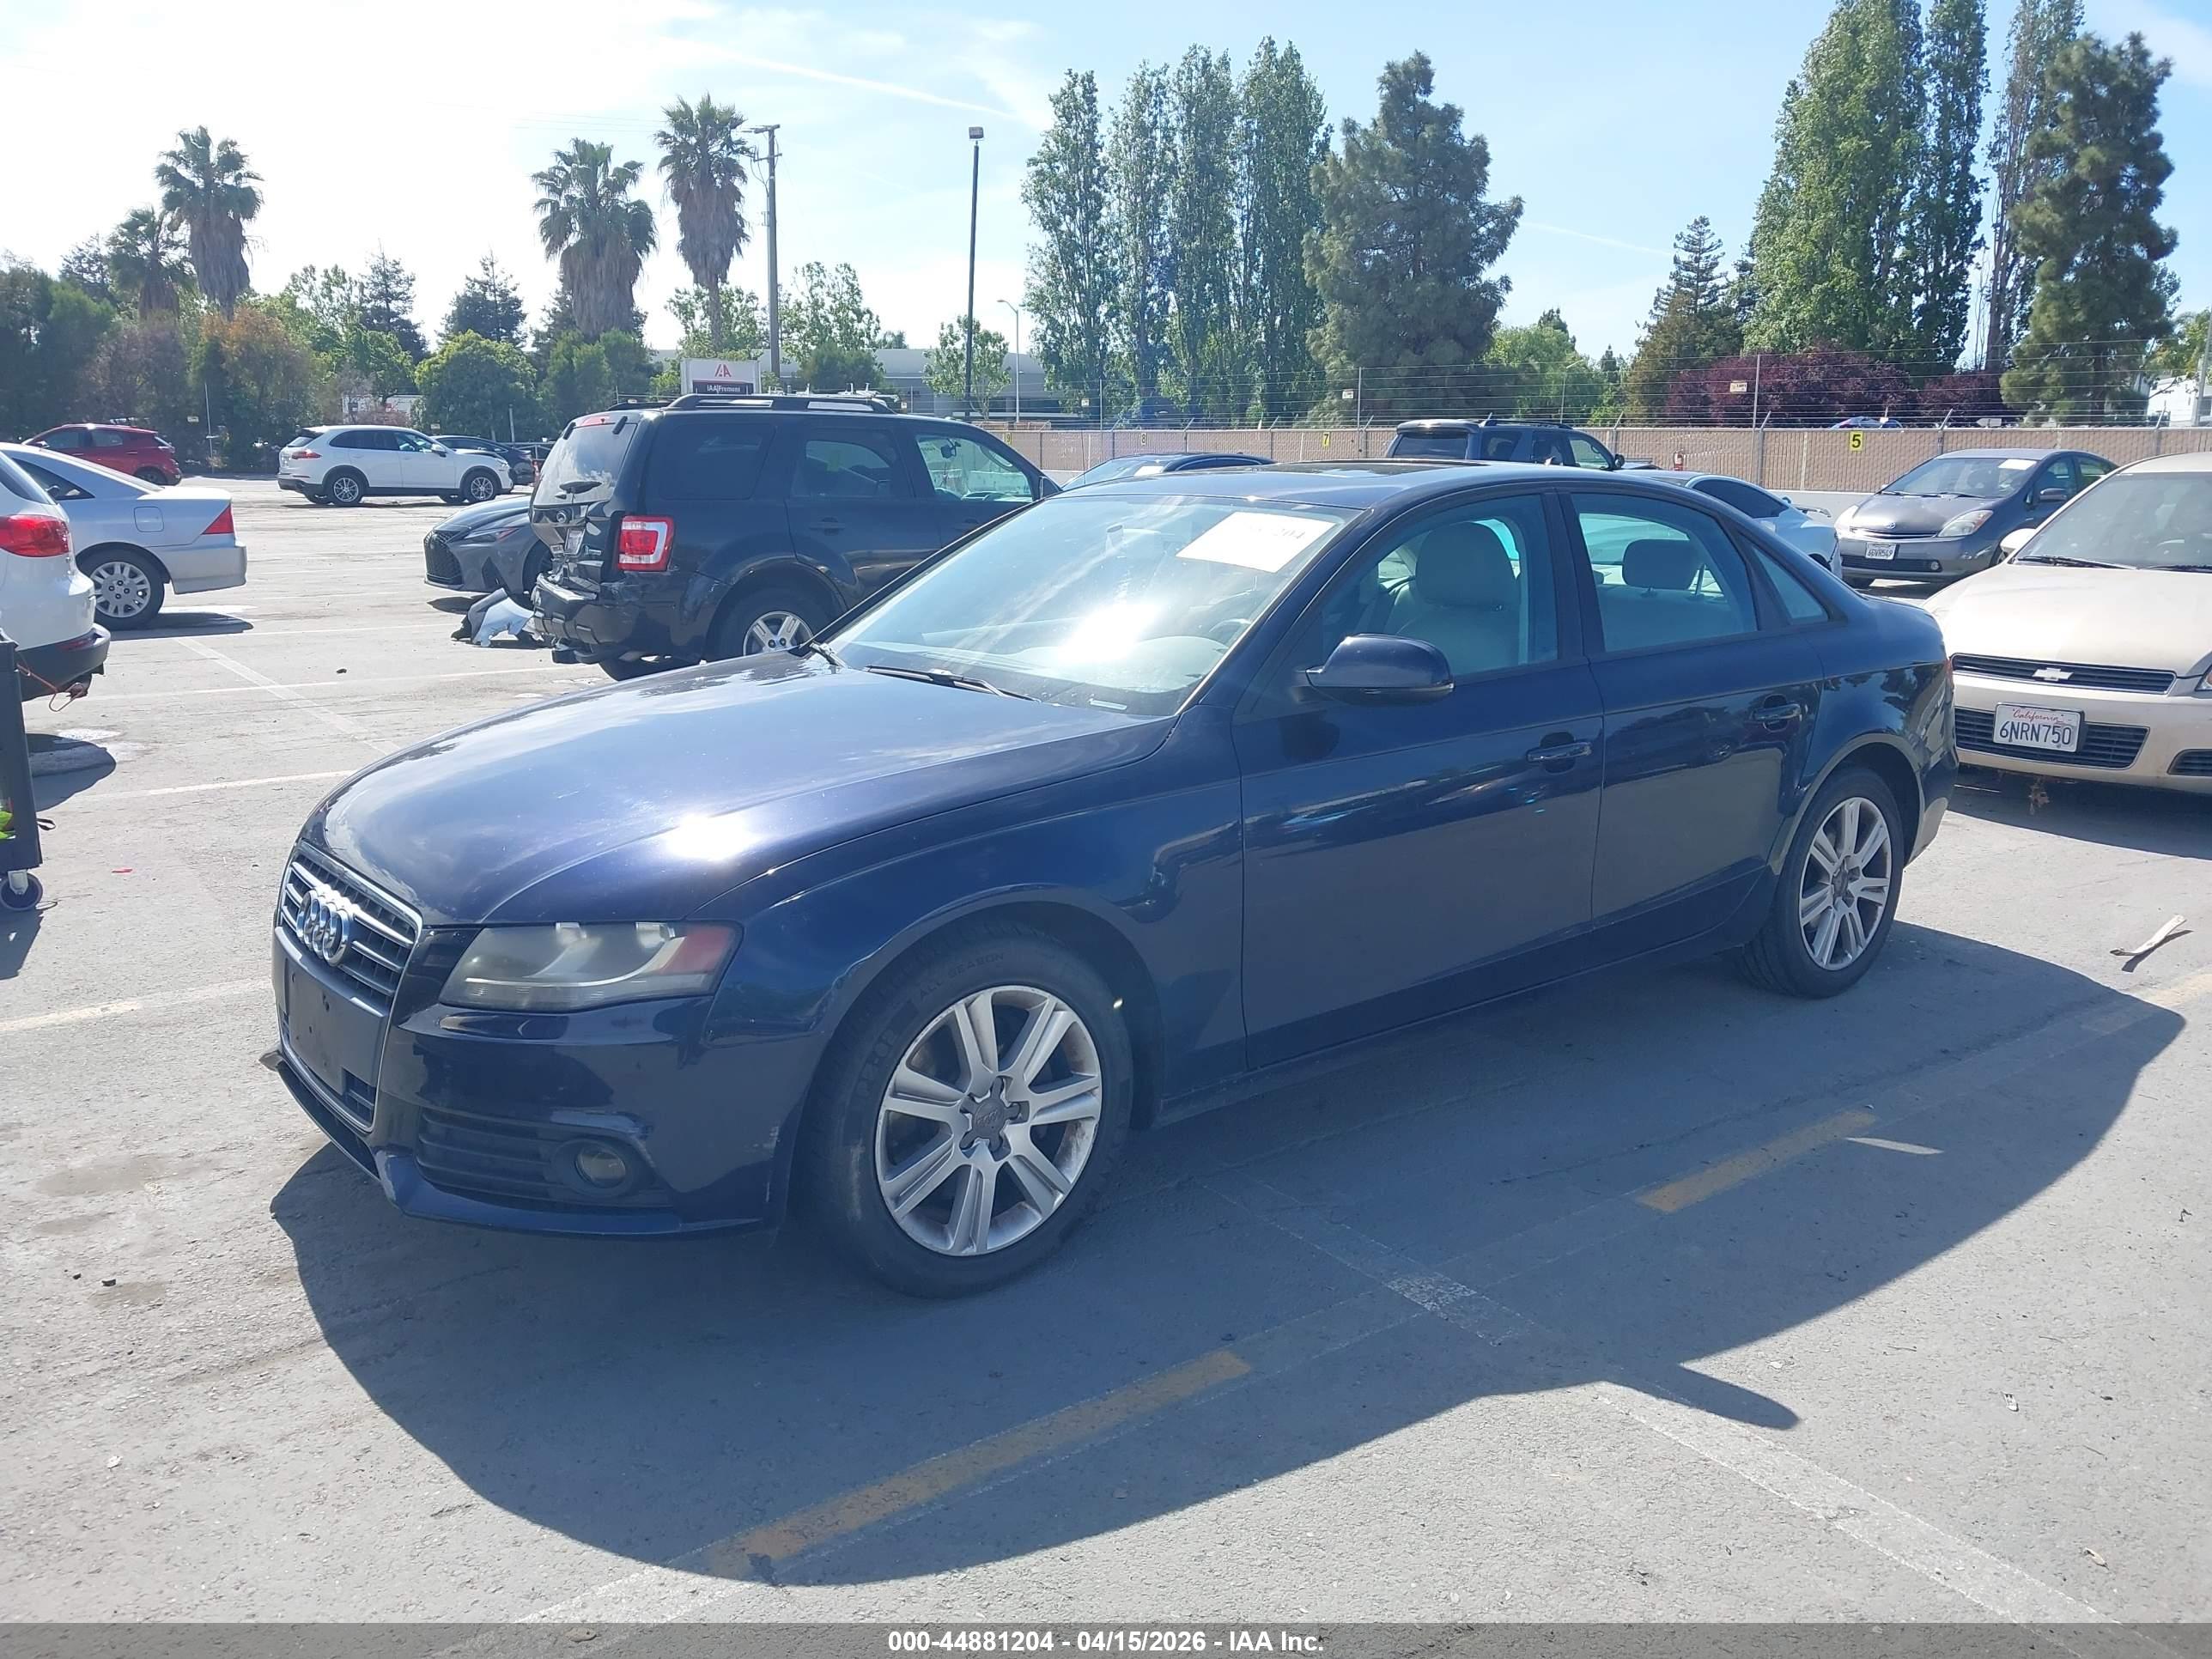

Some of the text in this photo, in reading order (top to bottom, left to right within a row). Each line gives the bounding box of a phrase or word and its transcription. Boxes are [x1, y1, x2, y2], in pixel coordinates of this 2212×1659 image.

[1851, 434, 1862, 448] 5
[2012, 708, 2059, 723] California
[1999, 721, 2072, 745] 6NRN750
[920, 952, 1004, 997] ALL SEASON
